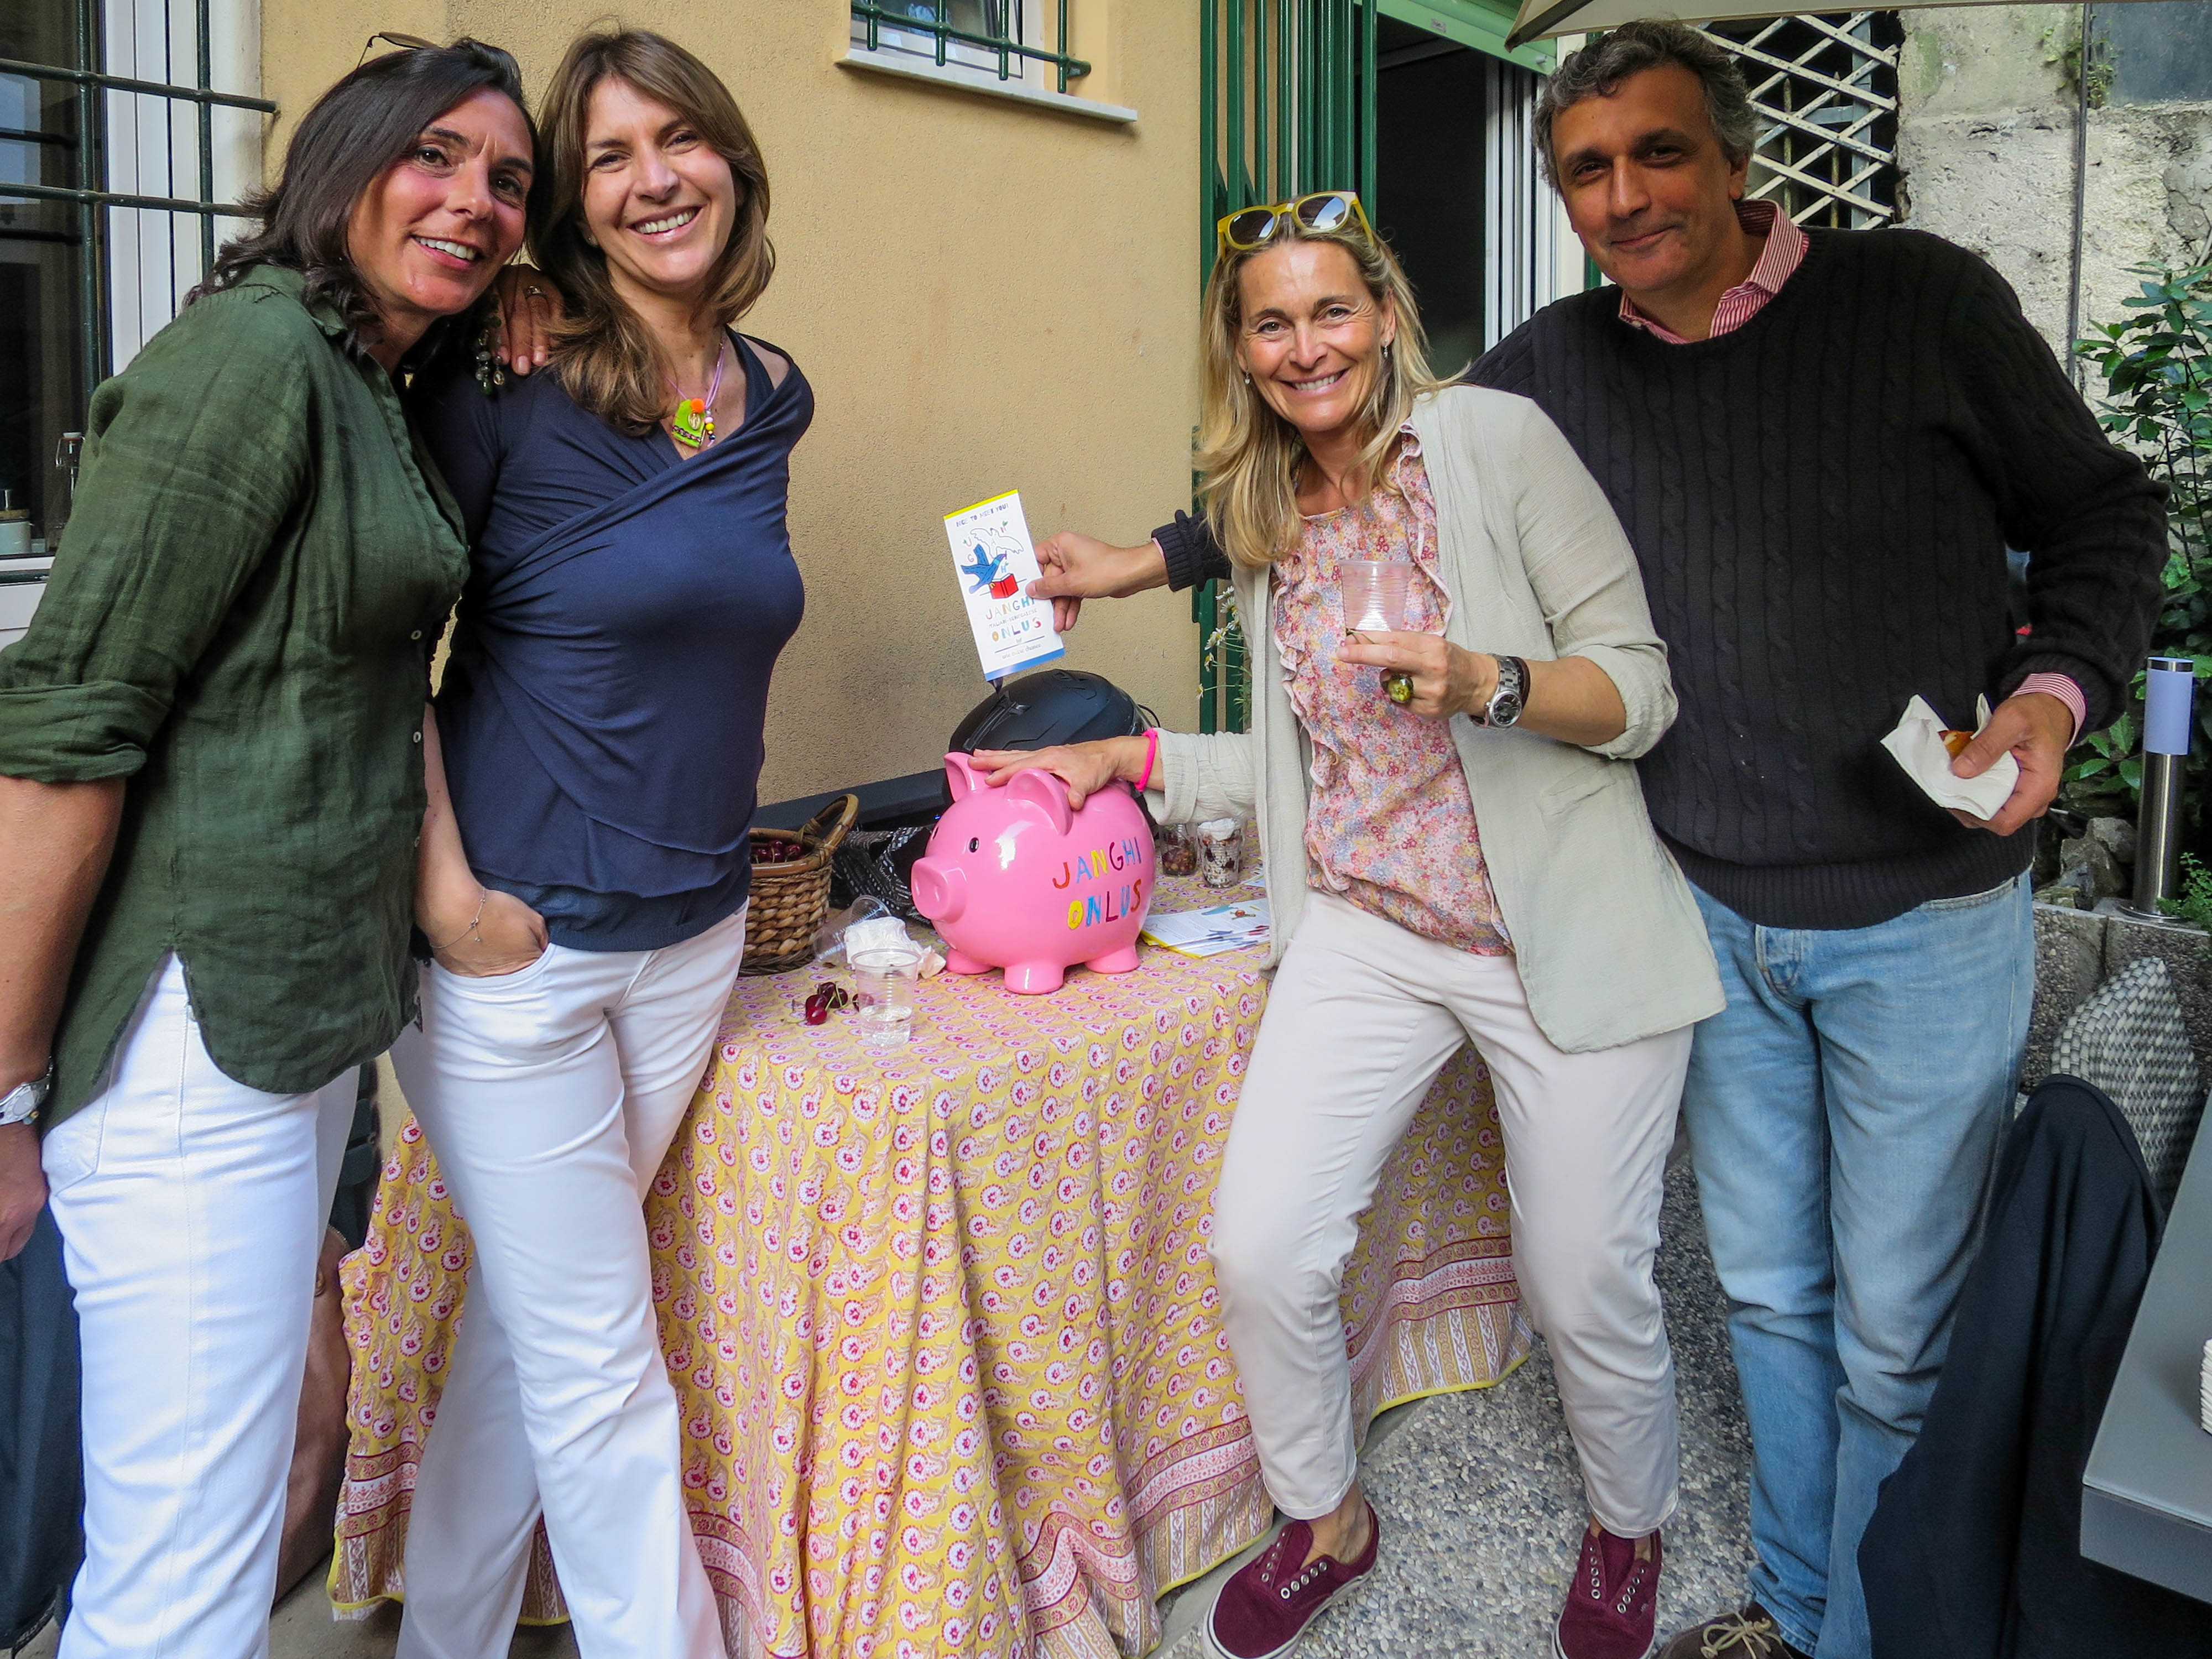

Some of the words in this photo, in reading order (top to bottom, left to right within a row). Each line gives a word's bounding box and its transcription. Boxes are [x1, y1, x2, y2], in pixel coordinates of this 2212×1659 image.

[992, 617, 1041, 641] ONLUS
[1052, 837, 1141, 889] JANGHI
[1067, 879, 1141, 930] ONLUS
